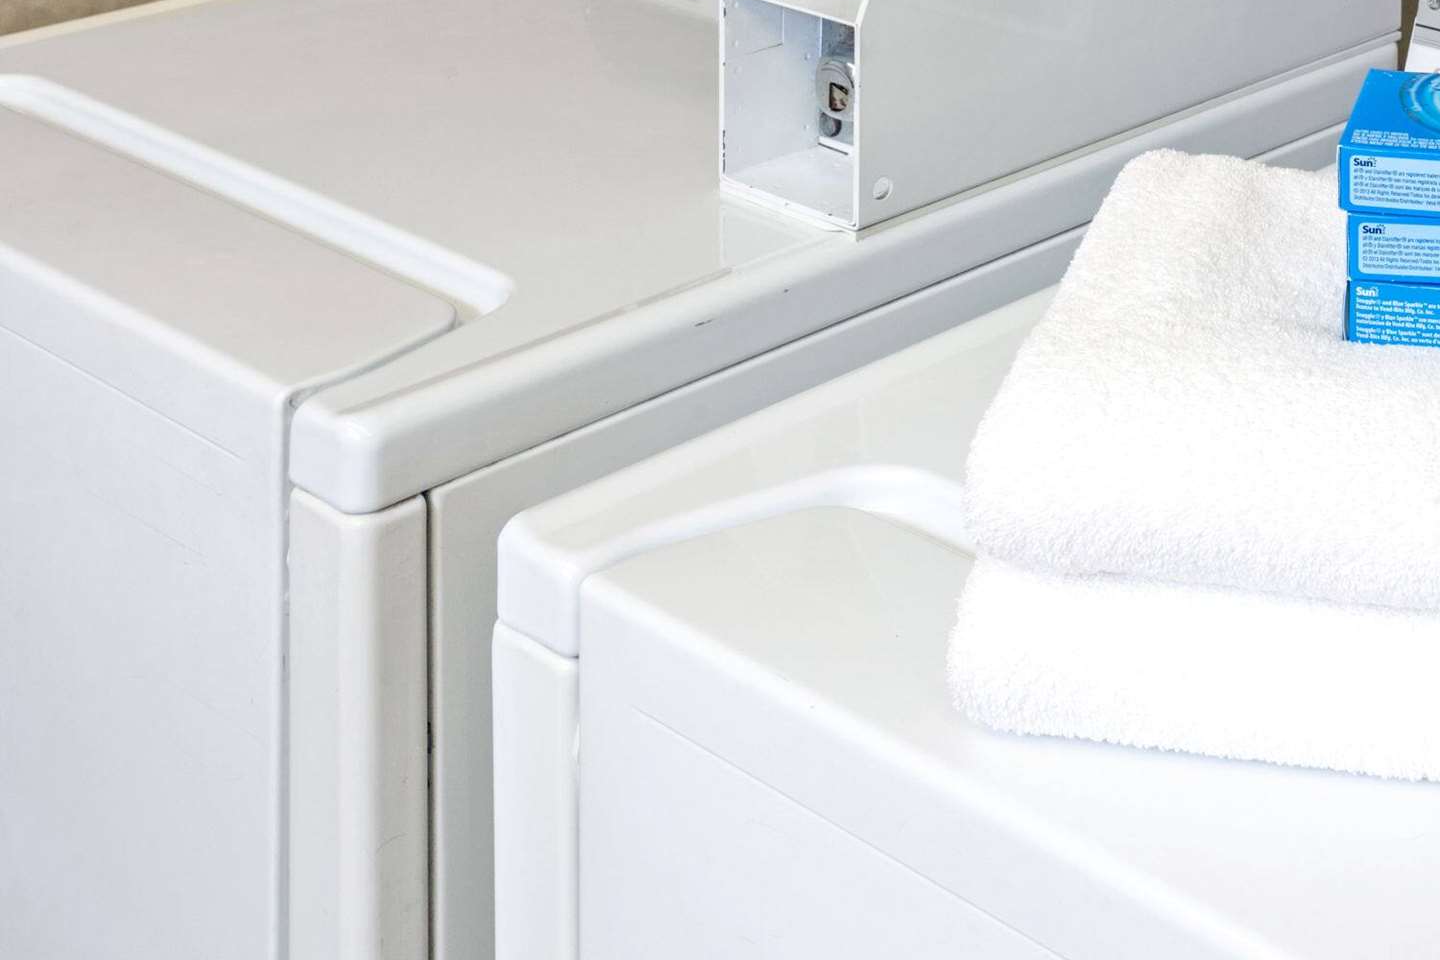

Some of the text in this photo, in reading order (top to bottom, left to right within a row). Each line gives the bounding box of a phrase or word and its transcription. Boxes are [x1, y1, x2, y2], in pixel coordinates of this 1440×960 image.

[1354, 158, 1373, 167] Sun
[1362, 225, 1382, 234] Sun
[1356, 287, 1376, 296] Sun
